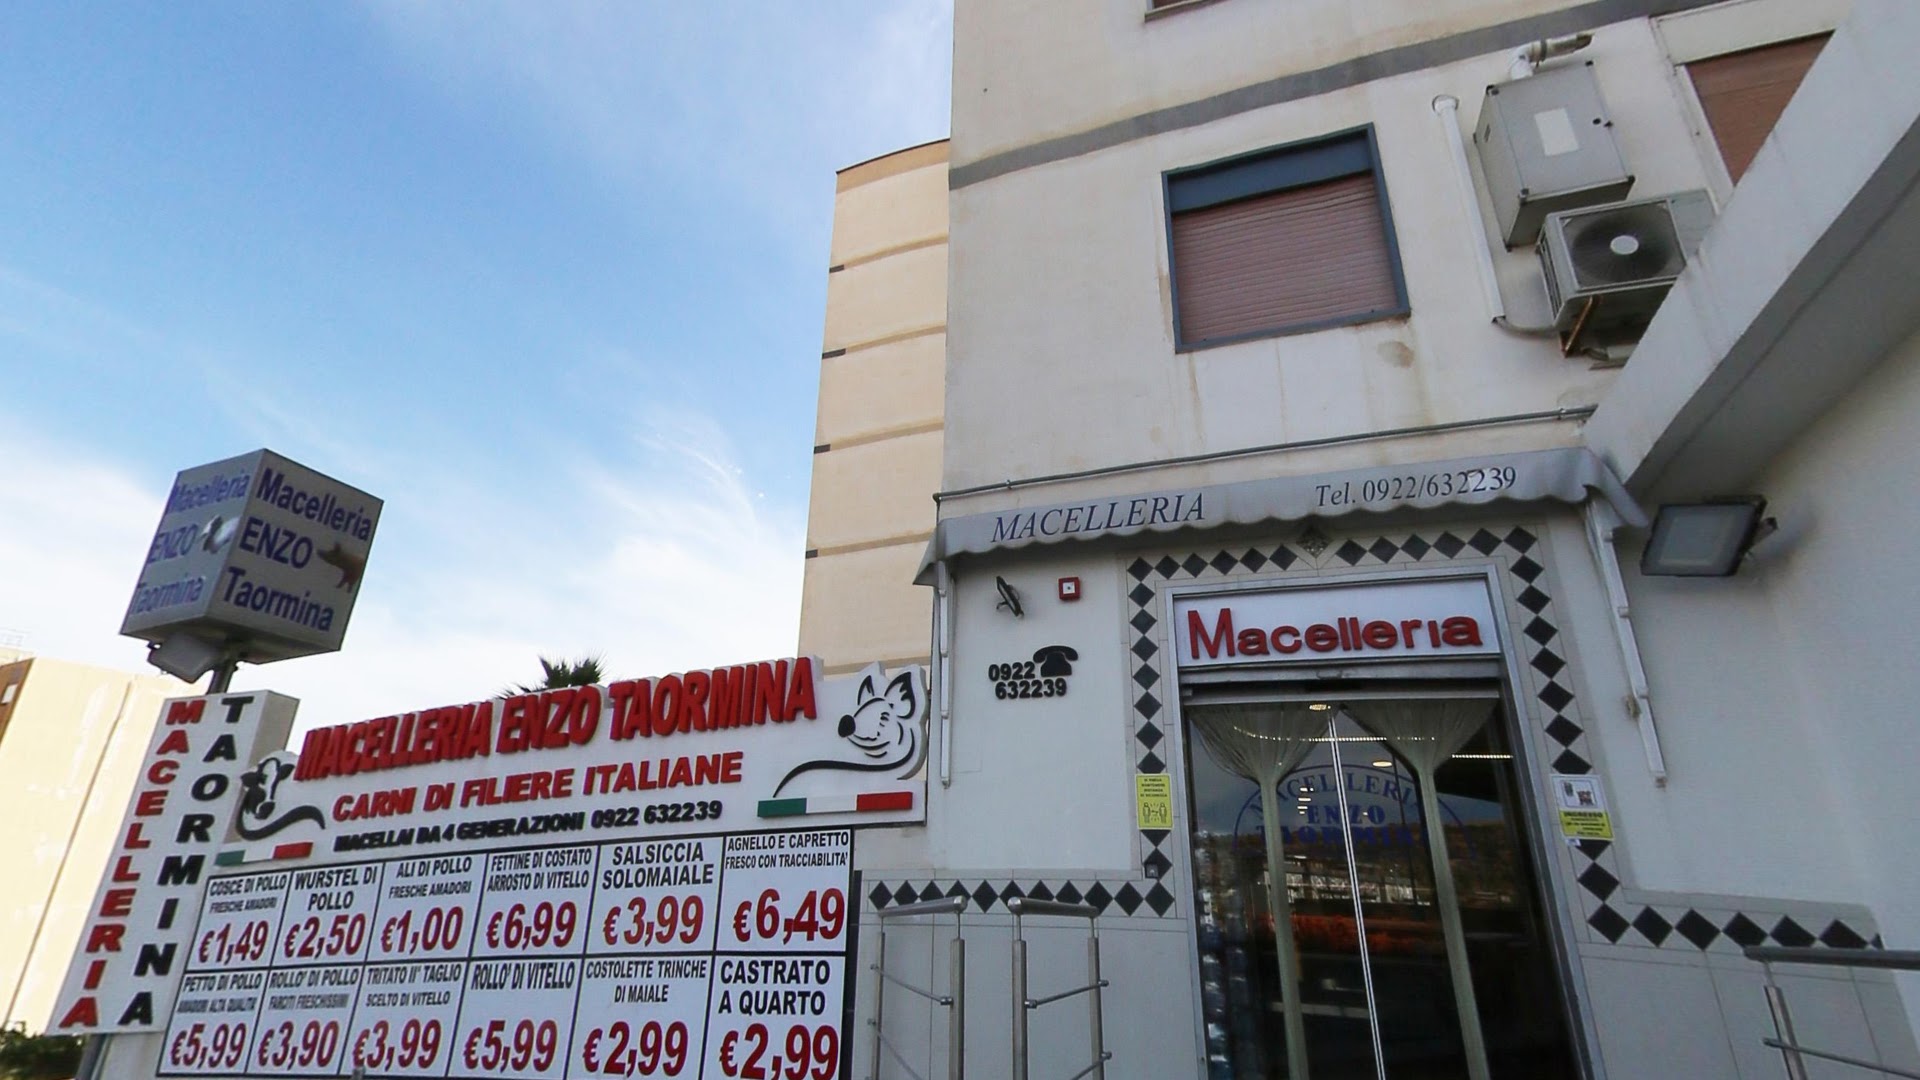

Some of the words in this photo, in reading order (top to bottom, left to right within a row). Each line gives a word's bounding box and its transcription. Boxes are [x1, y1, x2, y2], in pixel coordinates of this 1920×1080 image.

[1316, 482, 1356, 507] Tel.
[1363, 466, 1516, 503] 0922/632239
[256, 467, 372, 542] Macelleria
[990, 492, 1205, 543] MACELLERIA
[239, 516, 313, 569] ENZO
[221, 566, 335, 632] Taormina
[1187, 607, 1483, 660] Macelleria
[988, 661, 1035, 681] 0922
[995, 677, 1067, 700] 632239
[293, 700, 494, 781] MACELLERIA
[496, 684, 601, 753] ENZO
[608, 656, 817, 741] TAORMINA
[332, 786, 417, 822] CARNI
[423, 782, 455, 811] DI
[460, 768, 575, 808] FILIERE
[583, 751, 744, 796] ITALIANE
[333, 828, 415, 852] MACELLAI
[415, 825, 441, 844] DA
[442, 824, 456, 841] 4
[456, 811, 585, 841] GENERAZIONI
[591, 806, 640, 829] 0922
[643, 800, 723, 824] 632239
[1307, 805, 1386, 825] ENZO
[612, 842, 704, 866] SALSICCIA
[727, 836, 776, 852] AGNELLO
[778, 835, 785, 849] E
[788, 831, 849, 848] CAPRETTO
[59, 700, 207, 1028] MACELLERIA
[118, 696, 254, 1025] TAORMINA
[396, 861, 415, 879] ALI
[417, 860, 431, 877] DI
[432, 856, 472, 876] POLLO
[490, 851, 530, 872] FETTINE
[531, 850, 544, 869] DI
[544, 848, 592, 868] COSTATO
[725, 854, 757, 870] FRESCO
[758, 854, 777, 869] CON
[779, 852, 848, 868] TRACCIABILITA'
[209, 878, 243, 896] COSCE
[243, 876, 255, 893] DI
[255, 874, 288, 892] POLLO
[294, 869, 359, 891] WURSTEL
[362, 866, 378, 885] DI
[388, 883, 428, 899] FRESCHE
[428, 880, 472, 897] AMADORI
[486, 871, 532, 892] ARROSTO
[532, 871, 545, 890] DI
[547, 870, 590, 889] VITELLO
[602, 863, 714, 890] SOLOMAIALE
[209, 900, 244, 914] FRESCHE
[307, 891, 354, 911] POLLO
[284, 912, 366, 959] €2,50
[380, 905, 464, 955] €1,00
[486, 900, 577, 951] €6,99
[198, 920, 269, 966] €1,49
[183, 974, 215, 992] PETTO
[216, 974, 228, 990] DI
[229, 973, 263, 990] POLLO
[269, 970, 307, 989] ROLLO'
[307, 969, 320, 987] DI
[321, 968, 359, 987] POLLO
[366, 966, 408, 985] TRITATO
[422, 963, 462, 983] TAGLIO
[471, 963, 512, 990] ROLLO'
[511, 963, 525, 989] DI
[526, 961, 575, 989] VITELLO
[586, 960, 653, 979] COSTOLETTE
[657, 960, 707, 978] TRINCHE
[720, 959, 831, 985] CASTRATO
[366, 992, 399, 1007] SCELTO
[399, 992, 411, 1007] DI
[411, 991, 451, 1006] VITELLO
[614, 985, 628, 1003] DI
[628, 984, 669, 1003] MAIALE
[718, 990, 732, 1015] A
[739, 990, 826, 1016] QUARTO
[170, 1022, 247, 1069] €5,99
[258, 1019, 340, 1071] €3,90
[353, 1018, 441, 1072] €3,99
[463, 1018, 558, 1073] €5,99
